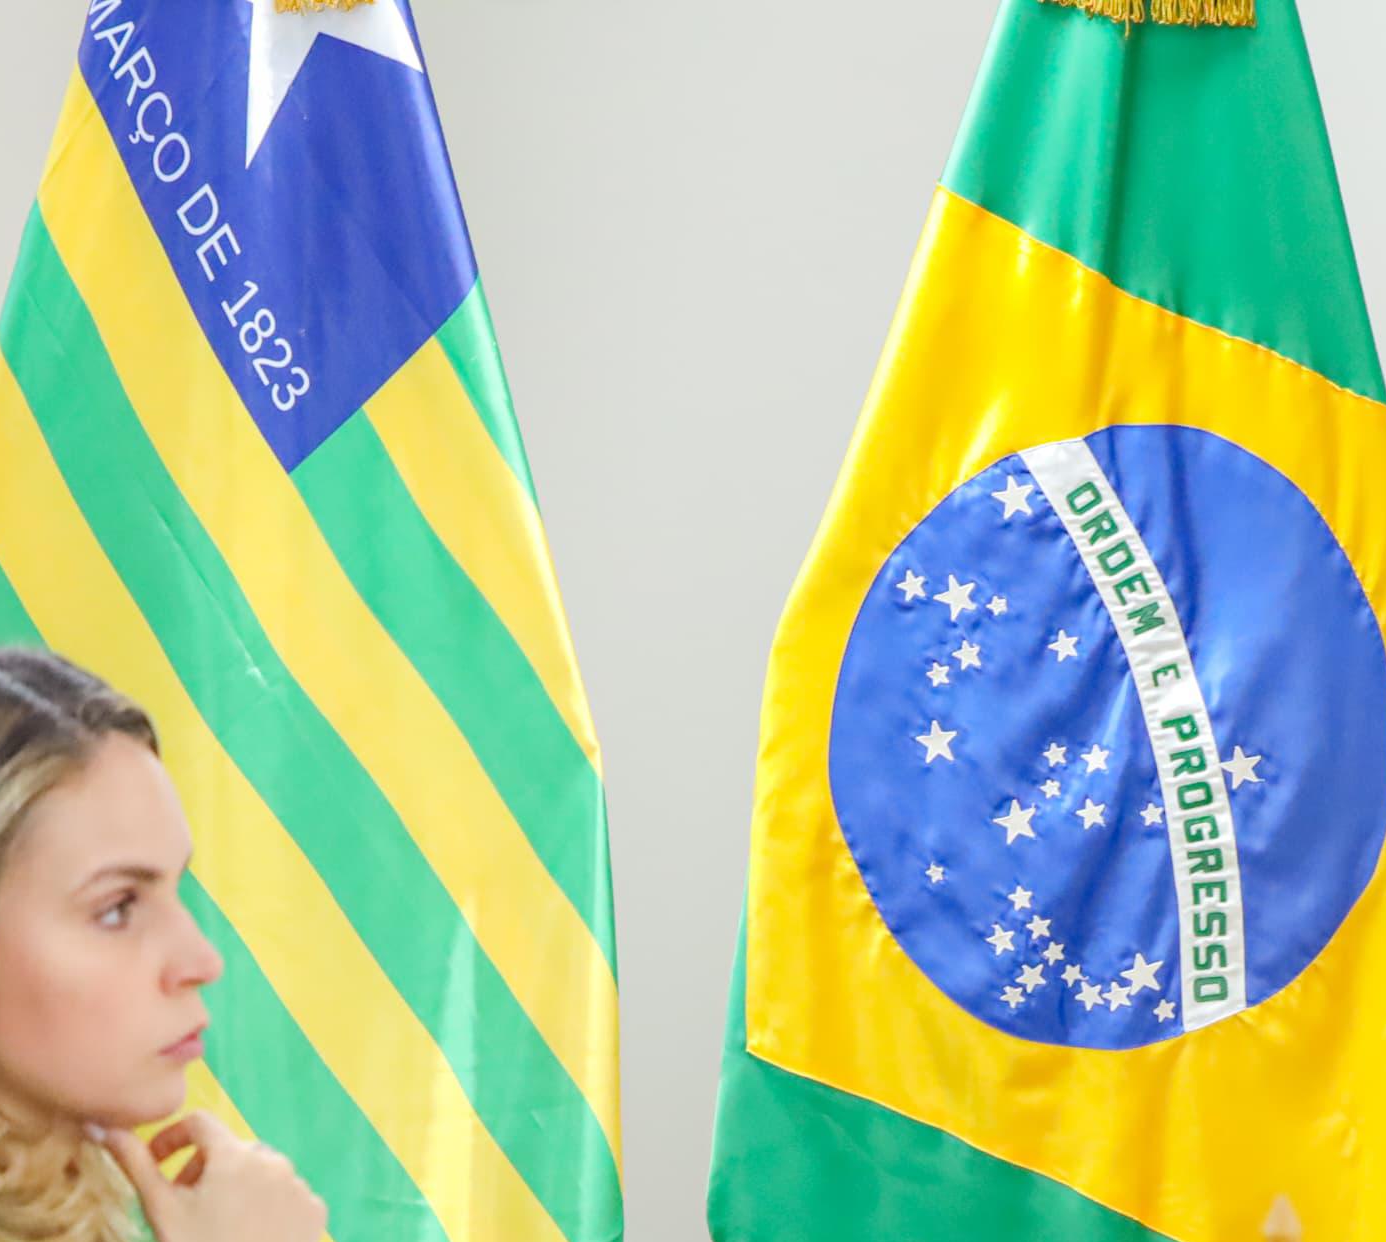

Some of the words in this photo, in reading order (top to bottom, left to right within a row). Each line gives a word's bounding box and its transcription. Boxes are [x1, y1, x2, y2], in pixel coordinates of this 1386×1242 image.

[177, 184, 241, 281] DE
[221, 280, 310, 412] 1823
[1066, 481, 1166, 636] ORDEM
[1152, 662, 1181, 688] E
[1161, 713, 1229, 1004] PROGRESSO
